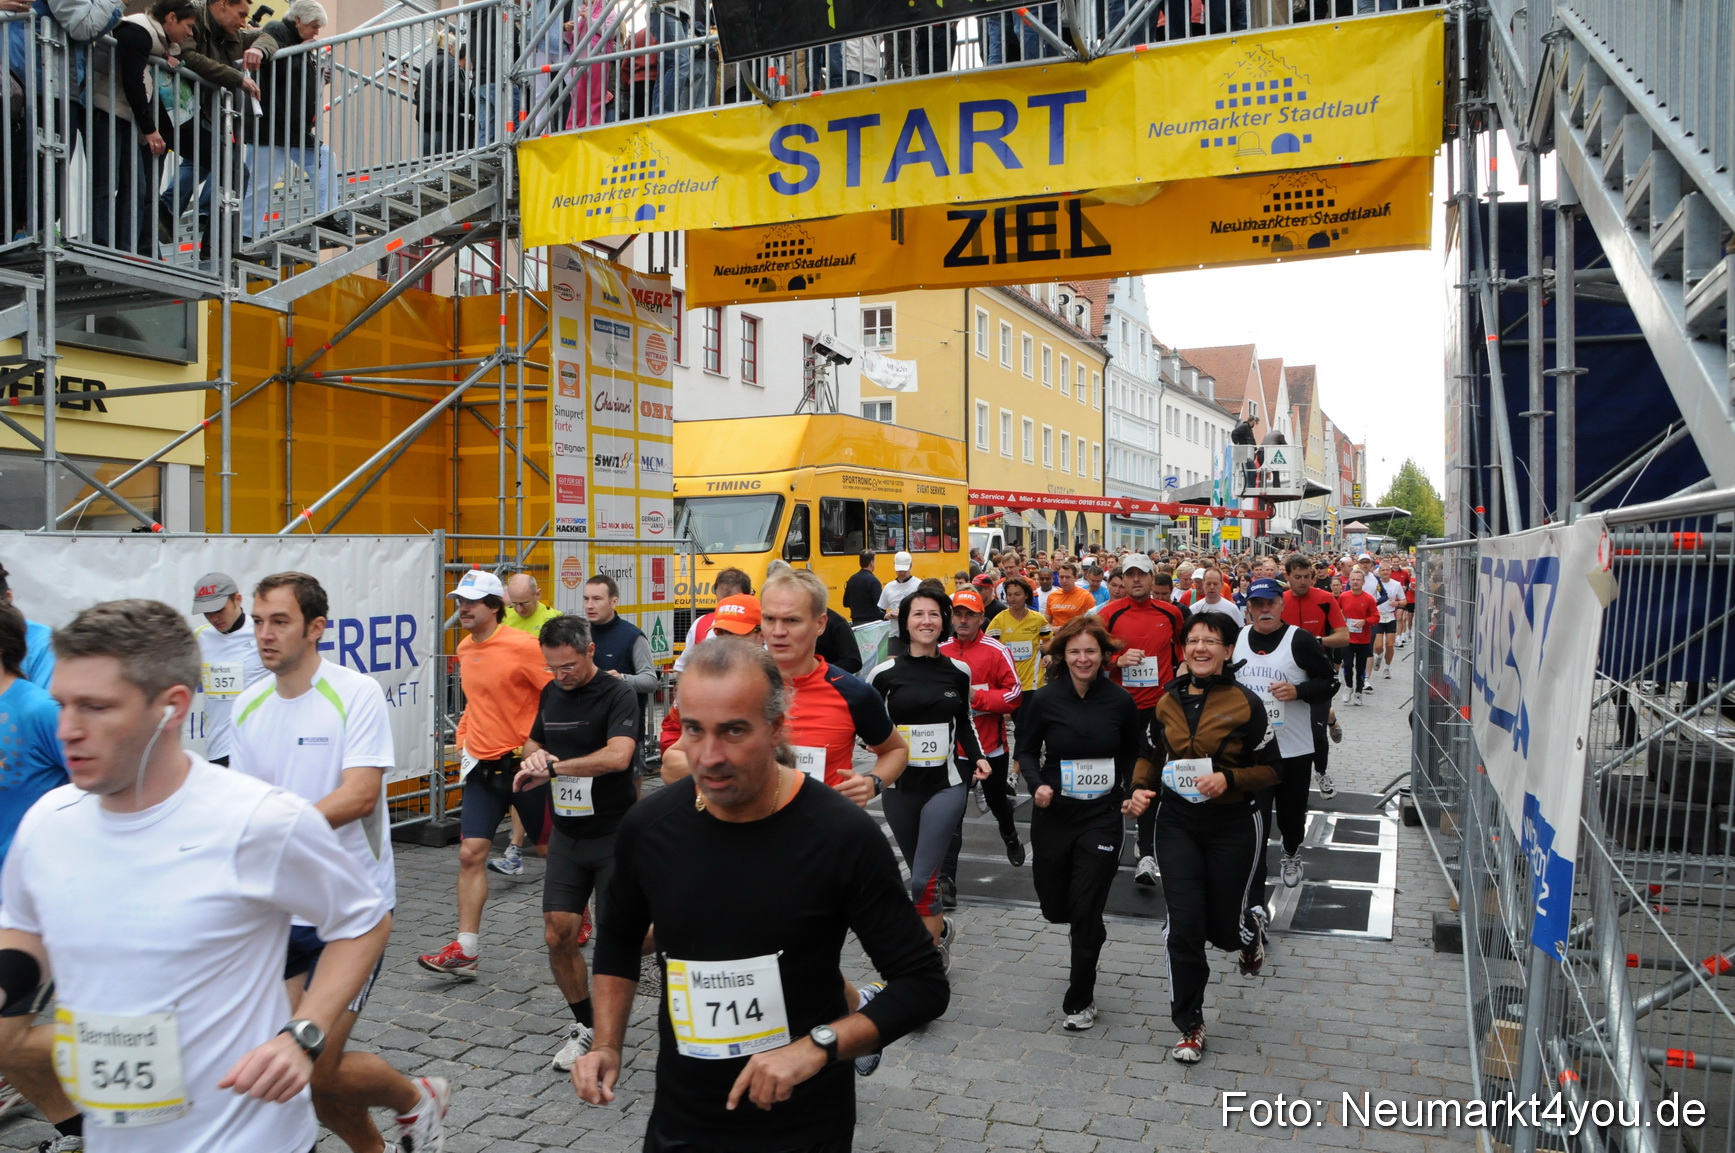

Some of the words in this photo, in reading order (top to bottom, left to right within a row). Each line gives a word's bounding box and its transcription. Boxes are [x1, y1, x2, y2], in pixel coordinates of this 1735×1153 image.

[1147, 111, 1272, 140] Neumarkter
[1276, 94, 1381, 123] Stadtlauf
[768, 89, 1088, 197] START
[551, 183, 639, 210] Neumarkter
[641, 175, 720, 197] Stadtlauf
[1210, 213, 1311, 235] Neumarkter
[1313, 201, 1392, 226] Stadtlauf
[943, 197, 1112, 268] ZIEL
[713, 258, 789, 277] Neumarkter
[790, 251, 858, 271] Stadtlauf
[631, 288, 672, 307] MERZ
[0, 367, 108, 413] EBER
[554, 405, 584, 420] Sinupret
[640, 401, 673, 420] OBI
[554, 419, 573, 432] forte
[641, 455, 664, 471] MCM
[706, 480, 761, 491] TIMING
[842, 474, 872, 486] SPORTRONIC
[916, 484, 930, 494] EVENT
[930, 485, 946, 496] SERVICE
[980, 493, 1005, 501] Service
[1019, 496, 1036, 504] Miet-
[1042, 497, 1078, 506] Serviceline:
[556, 524, 587, 534] HACKNER
[598, 565, 633, 582] Sinupret
[1013, 646, 1030, 654] 3453
[1131, 667, 1154, 678] 3117
[214, 677, 236, 688] 357
[911, 729, 935, 738] Marion
[921, 741, 937, 753] 29
[1075, 762, 1094, 772] Tanja
[1174, 763, 1197, 773] Monika
[1077, 774, 1109, 787] 2028
[560, 787, 583, 802] 214
[691, 971, 756, 990] Matthias
[706, 997, 764, 1027] 714
[77, 1022, 159, 1047] Bernhard
[92, 1059, 156, 1090] 545
